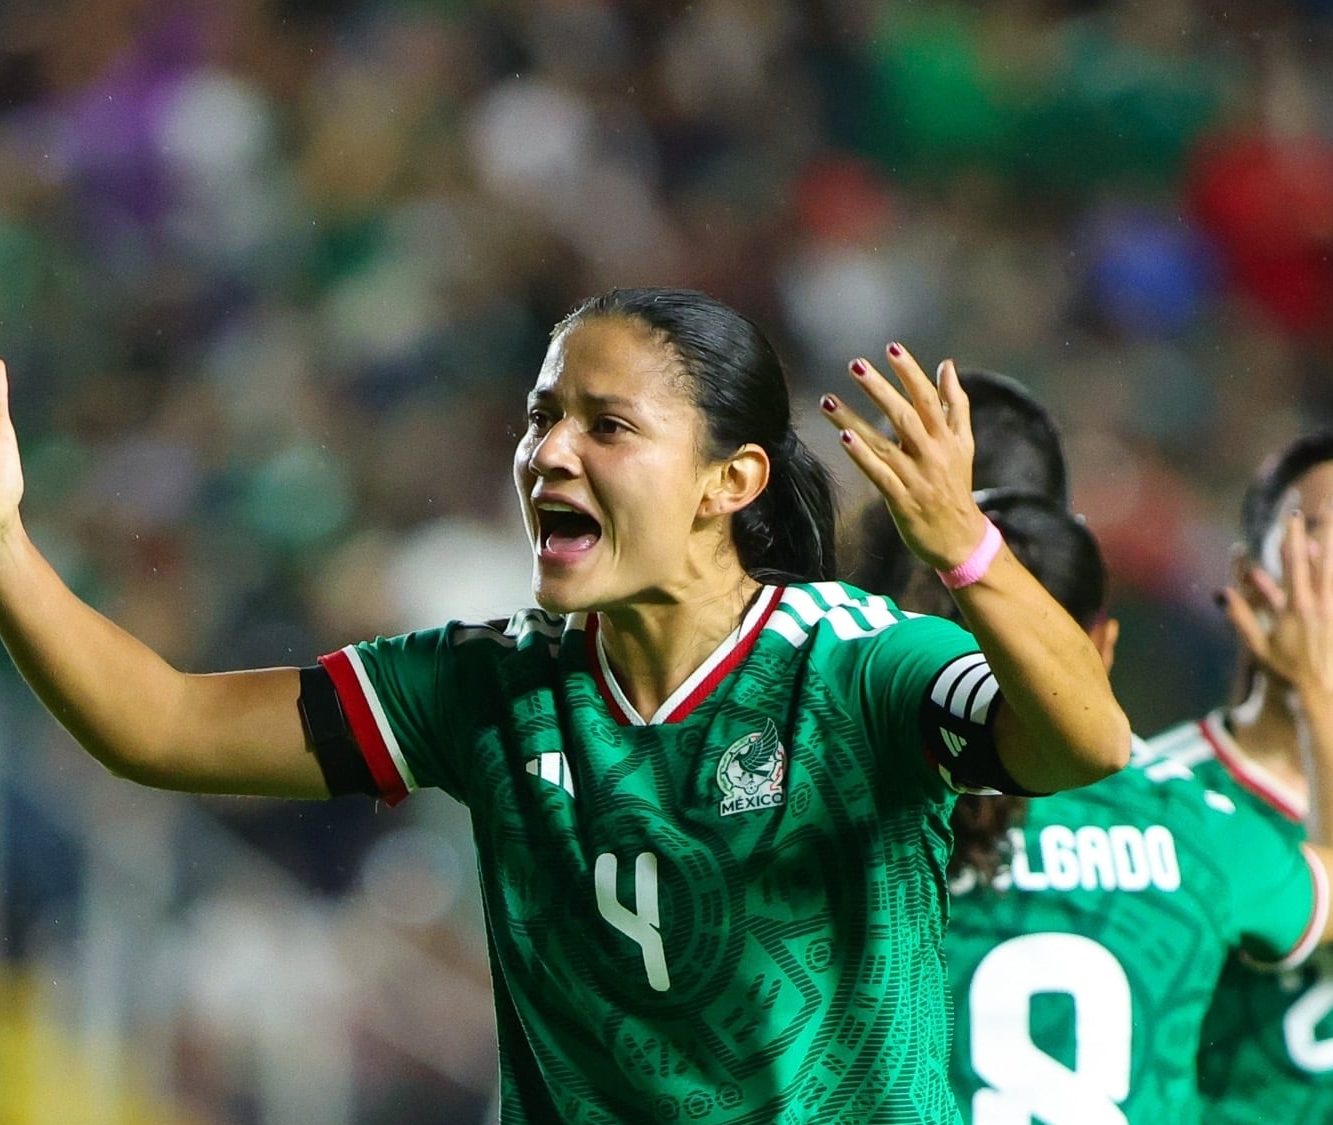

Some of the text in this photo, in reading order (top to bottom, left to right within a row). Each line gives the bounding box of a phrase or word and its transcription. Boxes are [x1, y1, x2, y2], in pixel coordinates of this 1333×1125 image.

[721, 792, 784, 814] MÉXICO
[950, 824, 1182, 896] LGADO
[594, 852, 671, 992] 4
